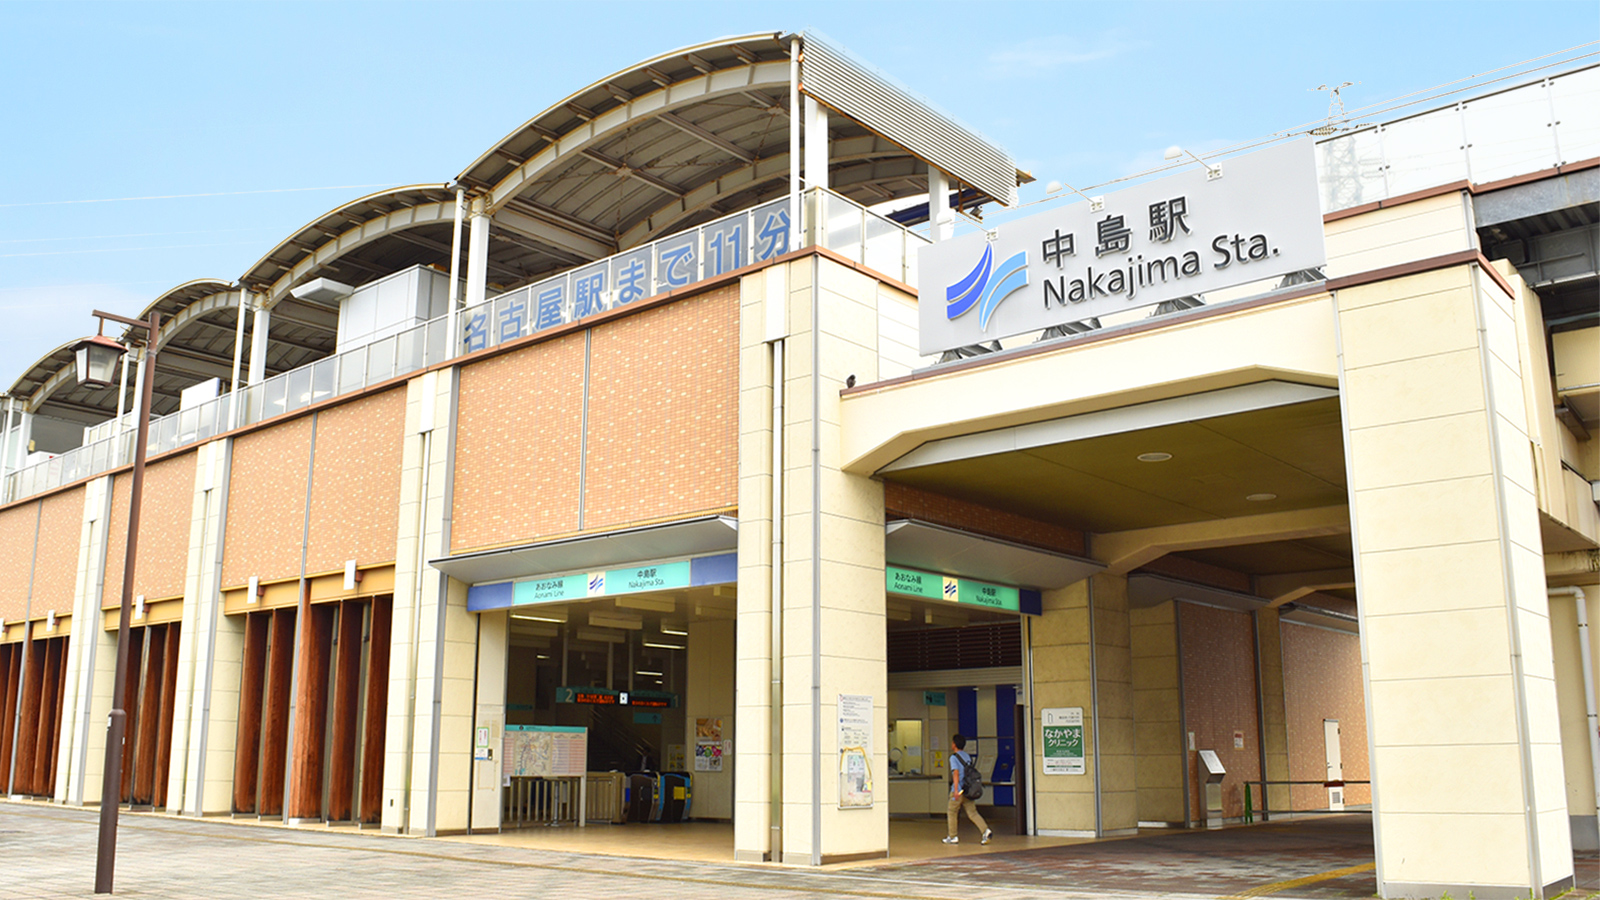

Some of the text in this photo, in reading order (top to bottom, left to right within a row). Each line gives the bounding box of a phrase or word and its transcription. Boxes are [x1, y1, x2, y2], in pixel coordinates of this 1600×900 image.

[1041, 195, 1192, 270] 中島駅
[1042, 229, 1281, 310] Nakajima Sta.
[463, 210, 791, 355] 名古屋駅まで11分
[637, 568, 657, 579] 中島駅
[535, 580, 564, 591] あおなみ線
[628, 579, 654, 589] Nakajima
[894, 582, 923, 593] Aonami Line
[534, 589, 564, 599] Aonami Line
[565, 688, 574, 703] 2
[1045, 729, 1081, 739] なかやま
[1048, 739, 1079, 747] クリニック
